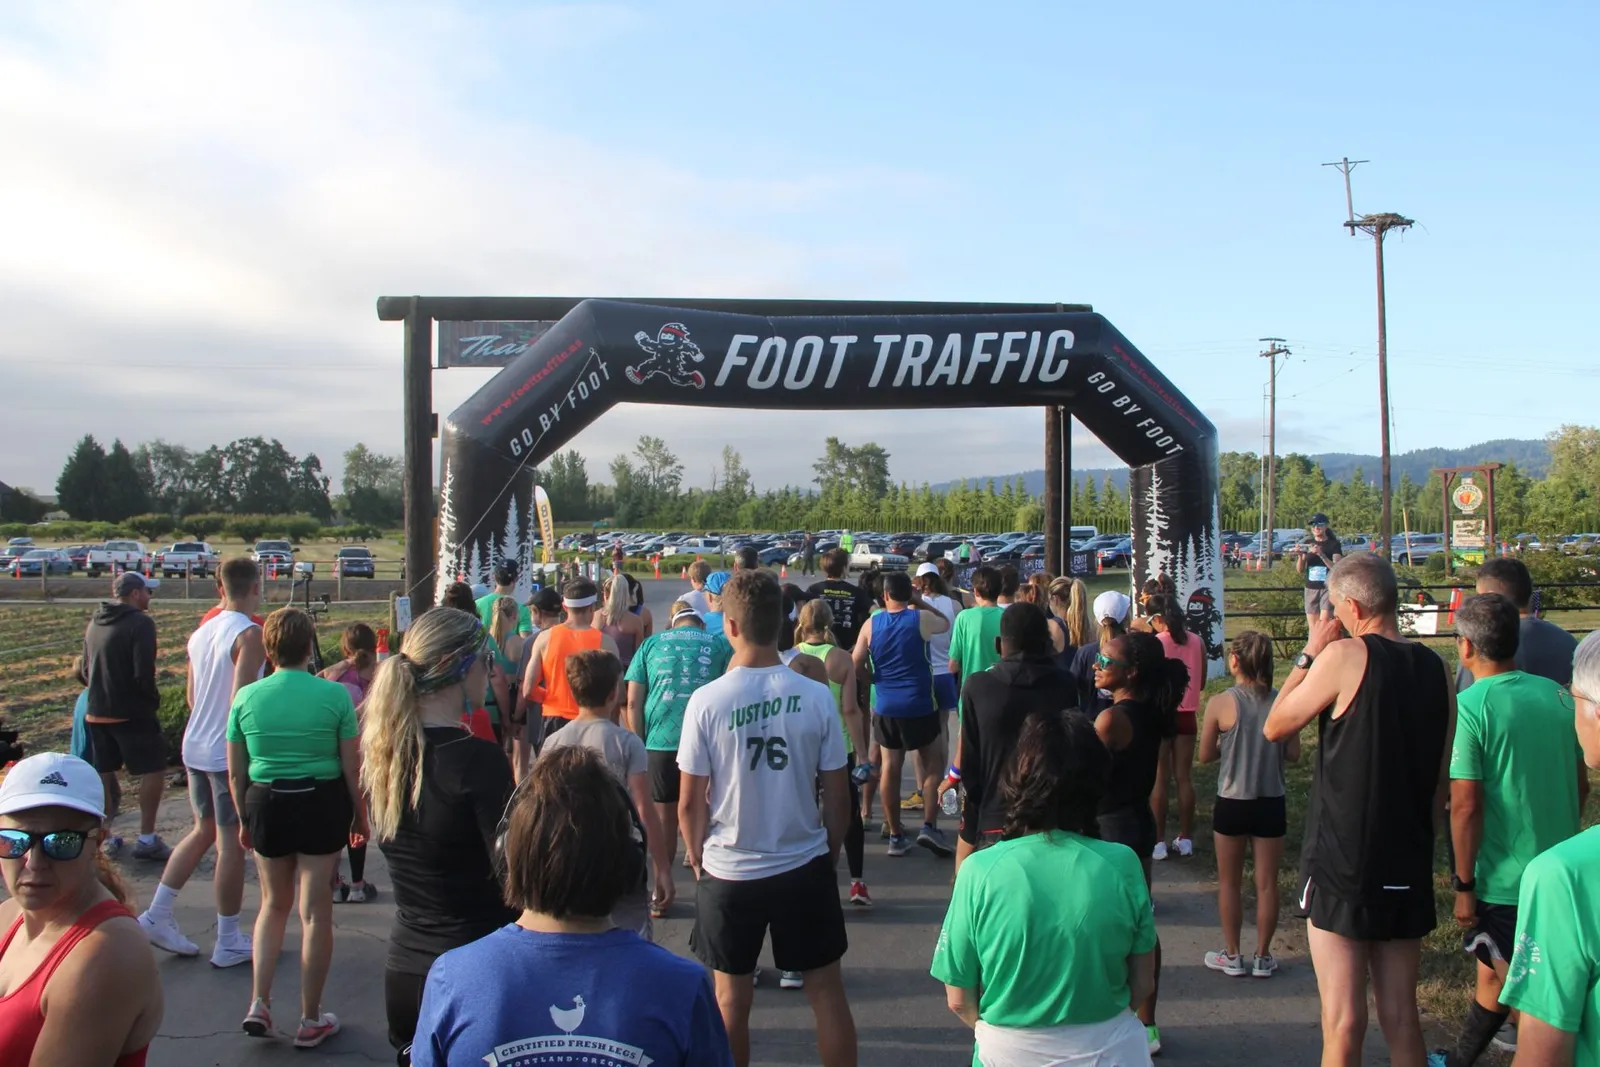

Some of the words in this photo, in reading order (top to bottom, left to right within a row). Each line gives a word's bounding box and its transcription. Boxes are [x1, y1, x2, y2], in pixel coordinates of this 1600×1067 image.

[714, 334, 858, 390] FOOT
[868, 329, 1075, 388] TRAFFIC
[509, 428, 533, 456] GO
[538, 403, 561, 432] BY
[567, 362, 610, 409] FOOT
[1087, 371, 1116, 393] GO
[1112, 395, 1141, 415] BY
[1136, 417, 1184, 455] FOOT
[728, 702, 761, 731] JUST
[762, 696, 782, 720] DO
[786, 695, 802, 713] IT.
[746, 736, 789, 771] 76
[40, 778, 68, 788] adidas
[501, 1040, 566, 1057] CERTIFIED
[567, 1039, 607, 1050] FRESH
[608, 1045, 637, 1060] LEGS
[581, 1056, 627, 1067] OREGO
